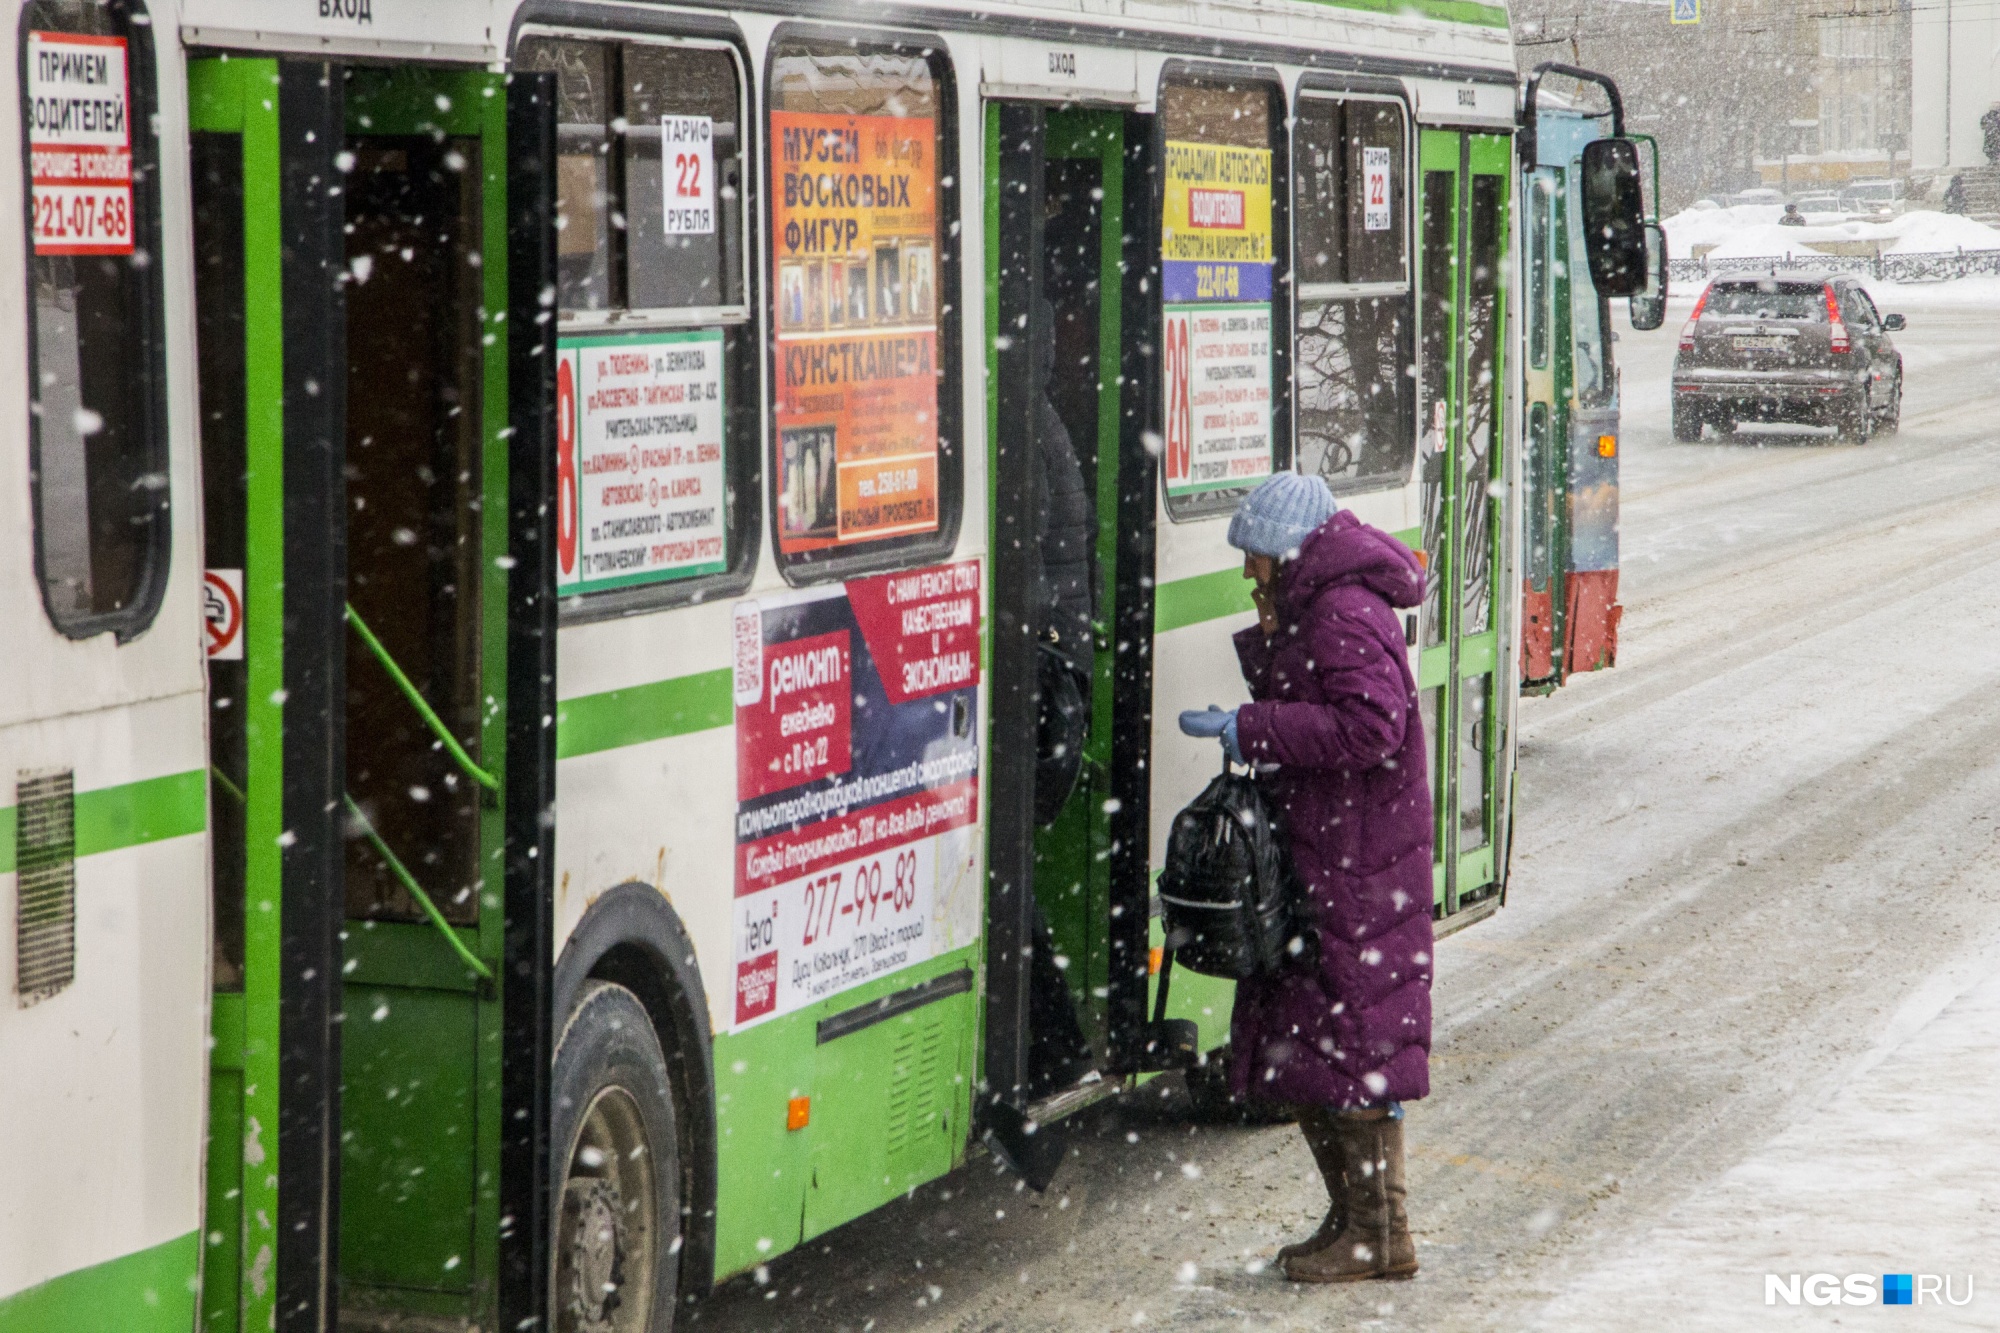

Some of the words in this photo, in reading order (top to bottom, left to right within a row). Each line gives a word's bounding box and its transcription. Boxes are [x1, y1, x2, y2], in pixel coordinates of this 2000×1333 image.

[318, 0, 372, 24] ВХОД
[39, 50, 108, 86] ПРИМЕМ
[1049, 52, 1076, 78] ВХОД
[1458, 89, 1476, 109] ВХОД
[664, 120, 709, 142] ТАРИФ
[783, 119, 860, 163] МУЗЕЙ
[675, 152, 701, 197] 22
[1365, 150, 1388, 166] ТАРИФ
[784, 173, 911, 208] ВОСКОВЫХ
[1371, 174, 1384, 205] 22
[33, 195, 127, 237] 221-07-68
[668, 208, 710, 231] РУБЛЯ
[1367, 212, 1388, 228] РУБЛЯ
[785, 218, 859, 254] ФИГУР
[784, 337, 931, 387] КУНСТКАМЕРА
[1164, 318, 1189, 480] 28
[902, 598, 972, 637] КАЧЕСТВЕННЫМ
[781, 700, 836, 737] ежедневно
[746, 840, 784, 880] Каждый
[803, 849, 916, 946] 277-99-83
